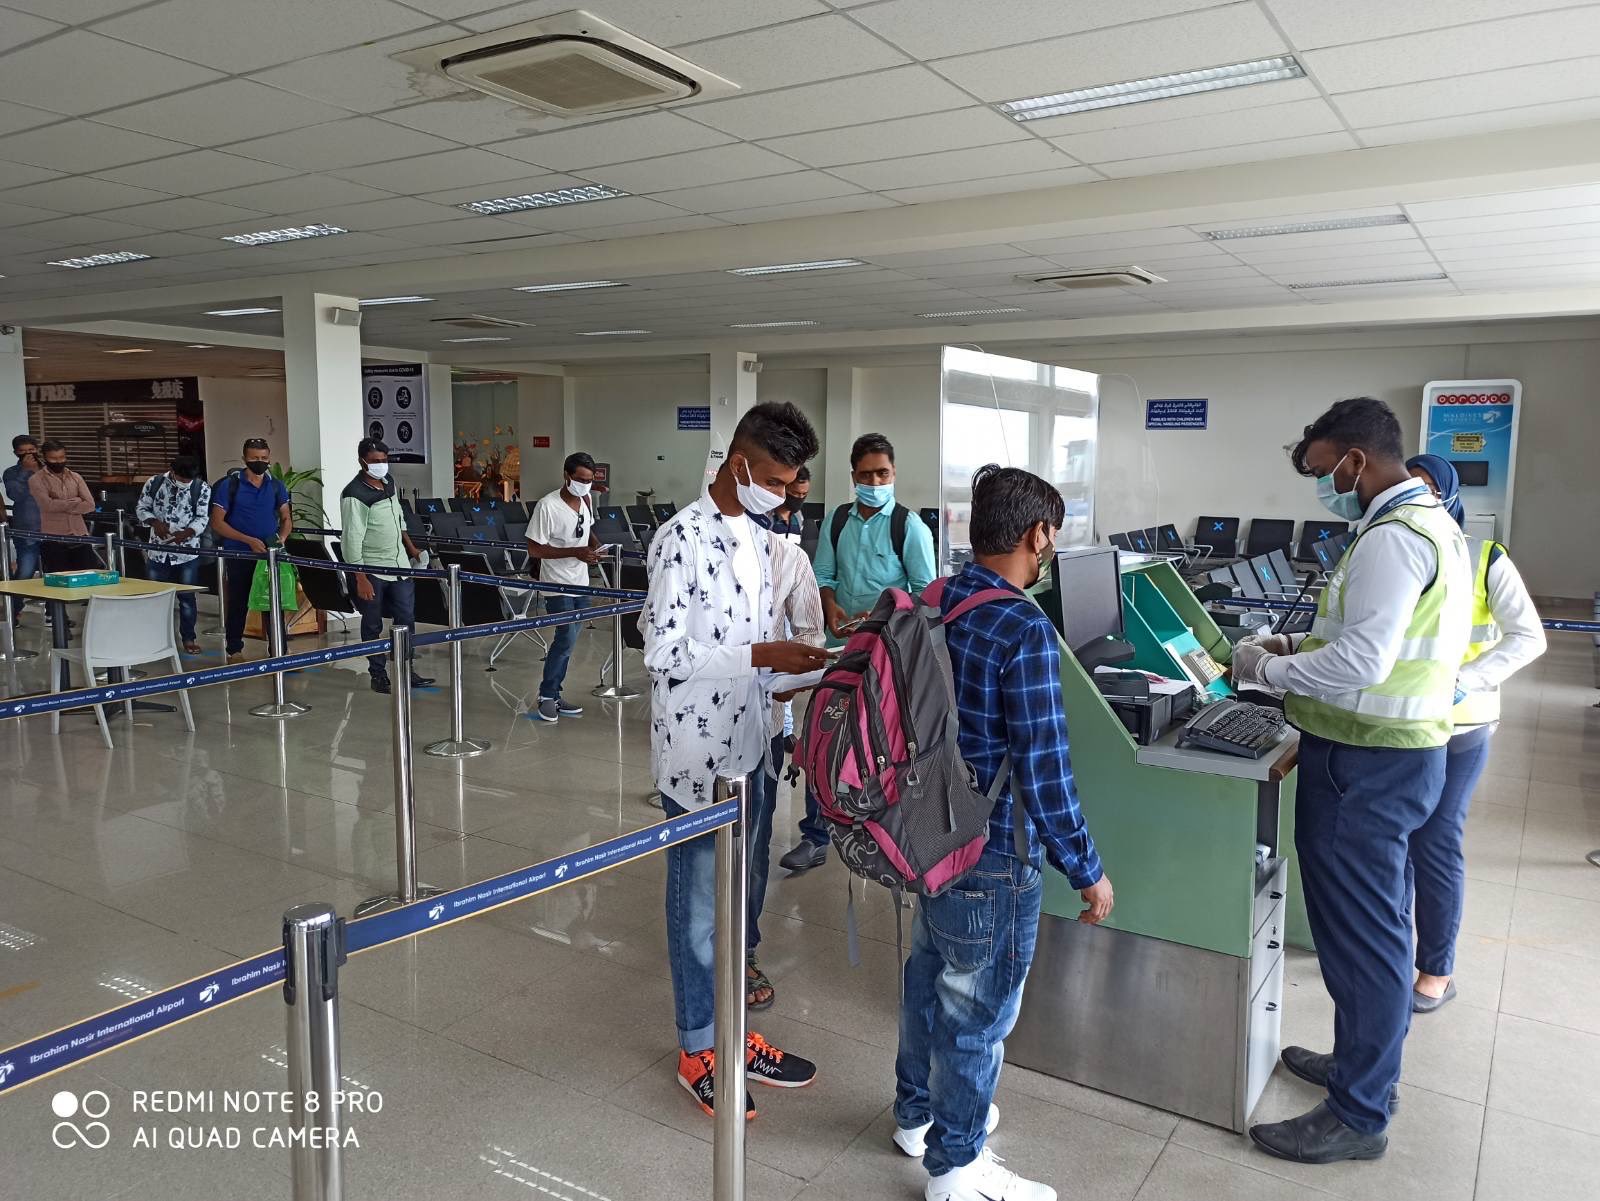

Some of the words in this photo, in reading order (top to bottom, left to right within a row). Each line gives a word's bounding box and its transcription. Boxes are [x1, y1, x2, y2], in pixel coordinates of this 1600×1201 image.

[1437, 394, 1510, 404] ooredoo
[453, 896, 476, 908] Ibrahim
[477, 890, 492, 900] Nasir
[492, 878, 528, 895] International
[528, 872, 547, 884] Airport
[231, 970, 261, 986] Ibrahim
[262, 961, 281, 974] Nasir
[29, 1044, 69, 1064] Ibrahim
[70, 1032, 95, 1048] Nasir
[97, 1009, 154, 1038] International
[156, 997, 185, 1016] Airport
